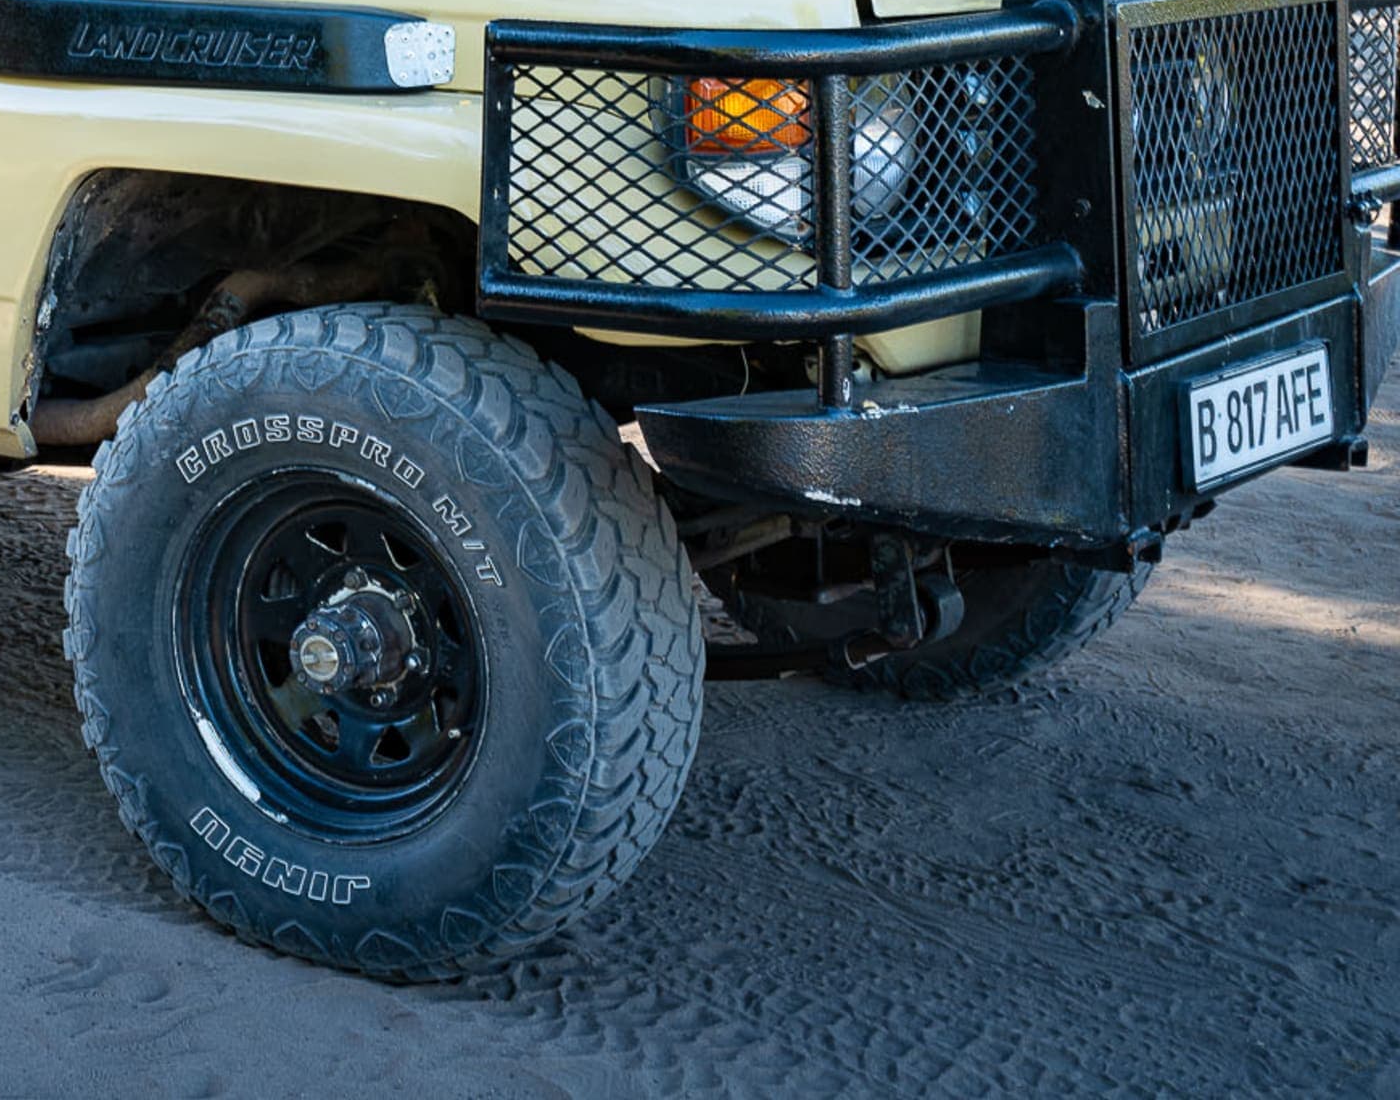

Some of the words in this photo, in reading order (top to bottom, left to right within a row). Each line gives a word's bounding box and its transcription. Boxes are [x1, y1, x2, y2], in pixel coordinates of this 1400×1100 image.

[1197, 398, 1217, 468] B
[1227, 380, 1268, 454] 817
[1276, 362, 1324, 440] AFE
[176, 413, 425, 490] CROSSPRO
[433, 494, 505, 587] M/T
[189, 805, 370, 904] JINYU
